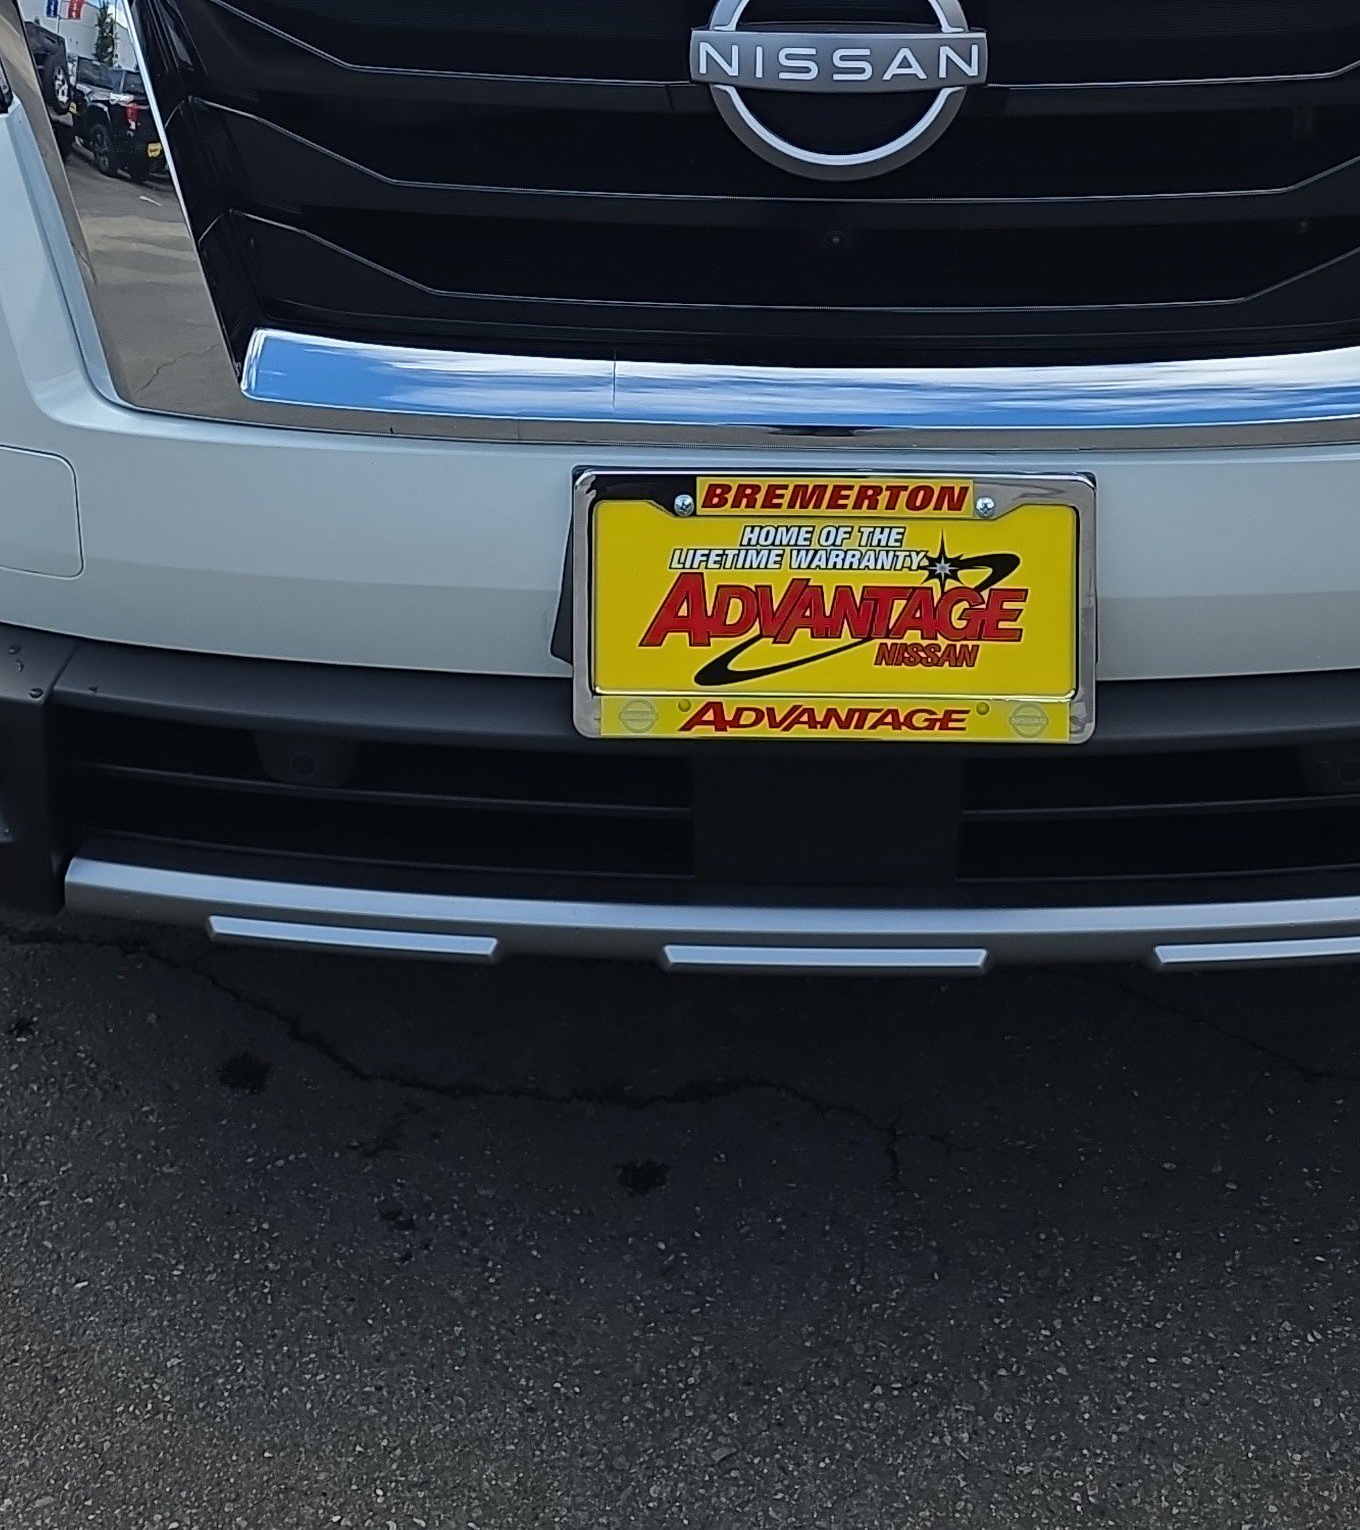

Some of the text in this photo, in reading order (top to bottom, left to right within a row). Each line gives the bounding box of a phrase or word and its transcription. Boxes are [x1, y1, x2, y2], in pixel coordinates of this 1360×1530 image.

[699, 41, 979, 81] NISSAN
[701, 483, 970, 512] BREMERTON
[740, 525, 906, 548] HOME OF THE
[669, 548, 929, 571] LIFETIME WARRANTY
[639, 572, 1030, 647] ADVANTAGE
[873, 642, 980, 668] NISSAN
[676, 701, 971, 732] ADVANTAGE
